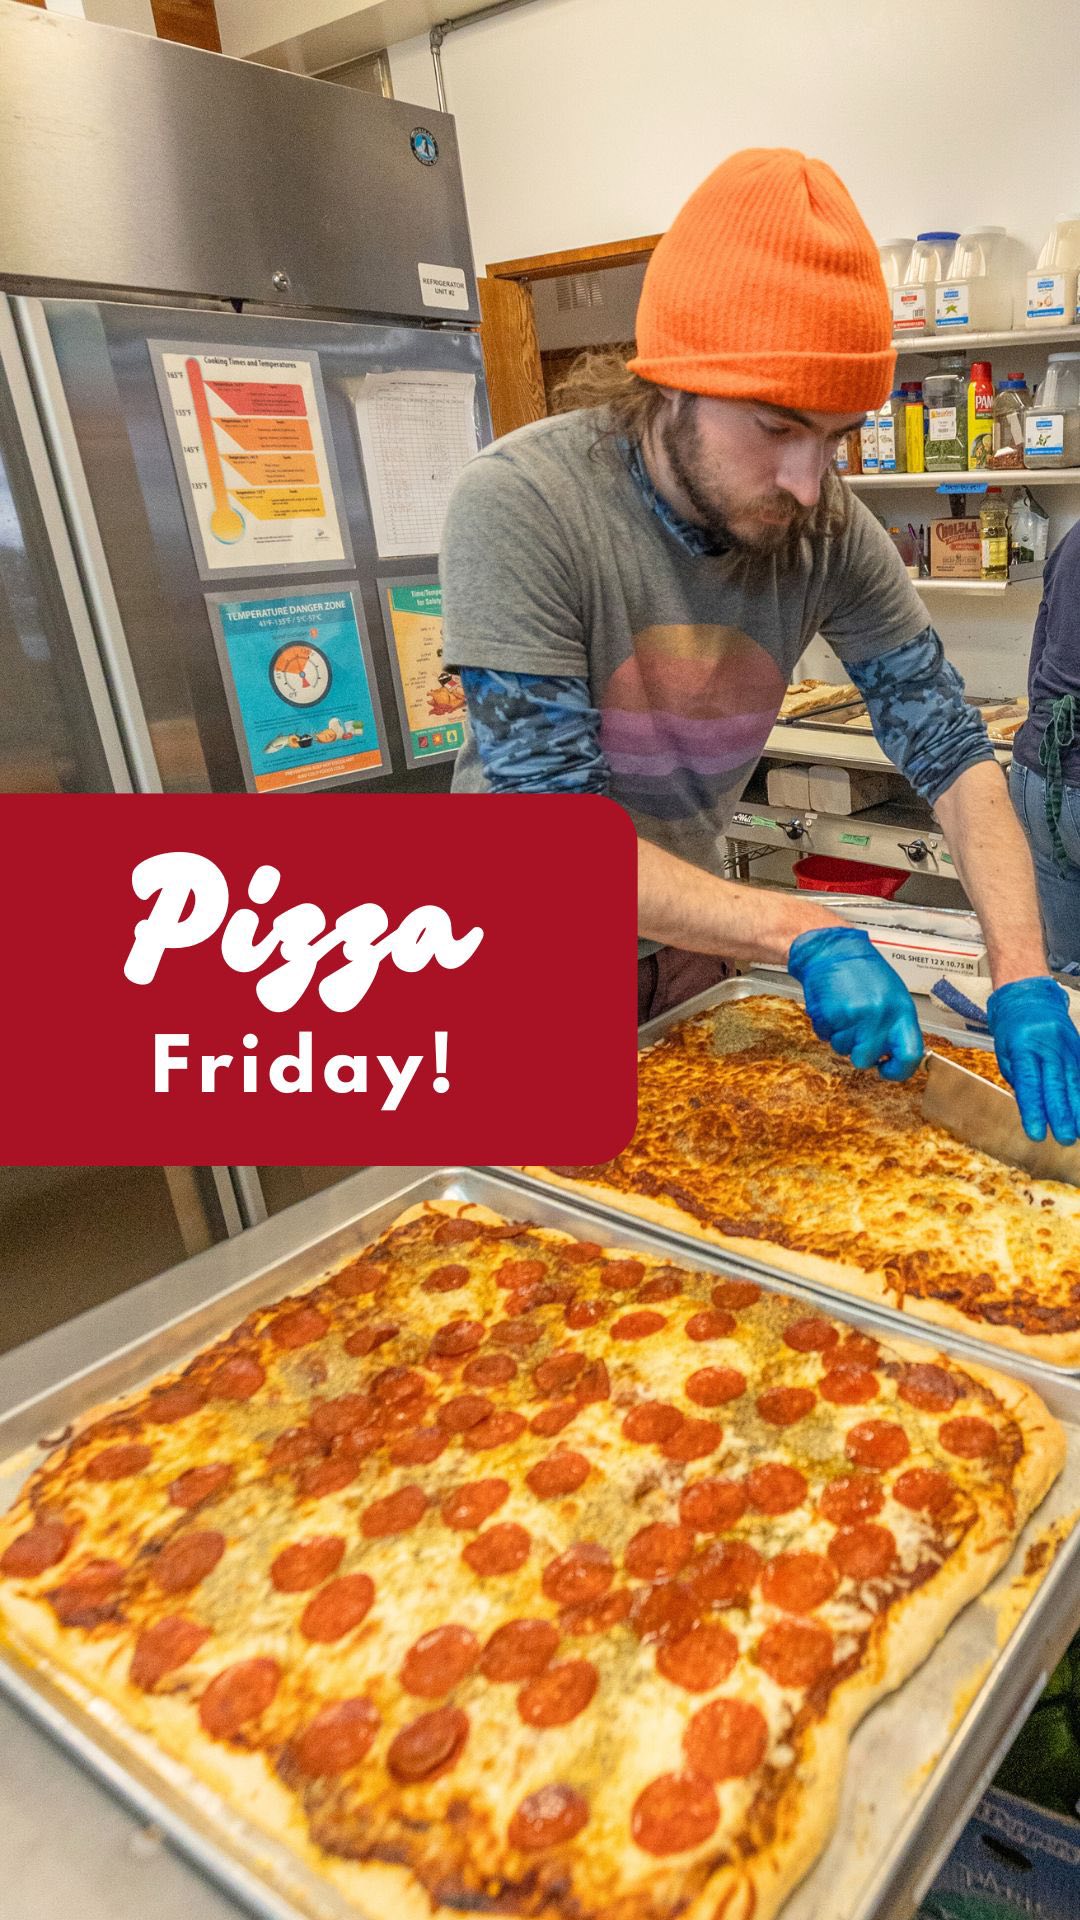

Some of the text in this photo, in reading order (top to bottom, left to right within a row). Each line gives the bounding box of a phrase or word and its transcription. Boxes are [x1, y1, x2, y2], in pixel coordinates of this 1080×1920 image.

[422, 278, 465, 288] REFRIGERATOR
[204, 356, 228, 366] Cooking
[229, 357, 246, 366] Times
[258, 359, 297, 369] Temperatures
[191, 482, 208, 490] 135°F
[226, 600, 347, 621] TEMPERATURE DANGER ZONE
[908, 955, 928, 964] SHEET
[946, 961, 965, 969] 10.75
